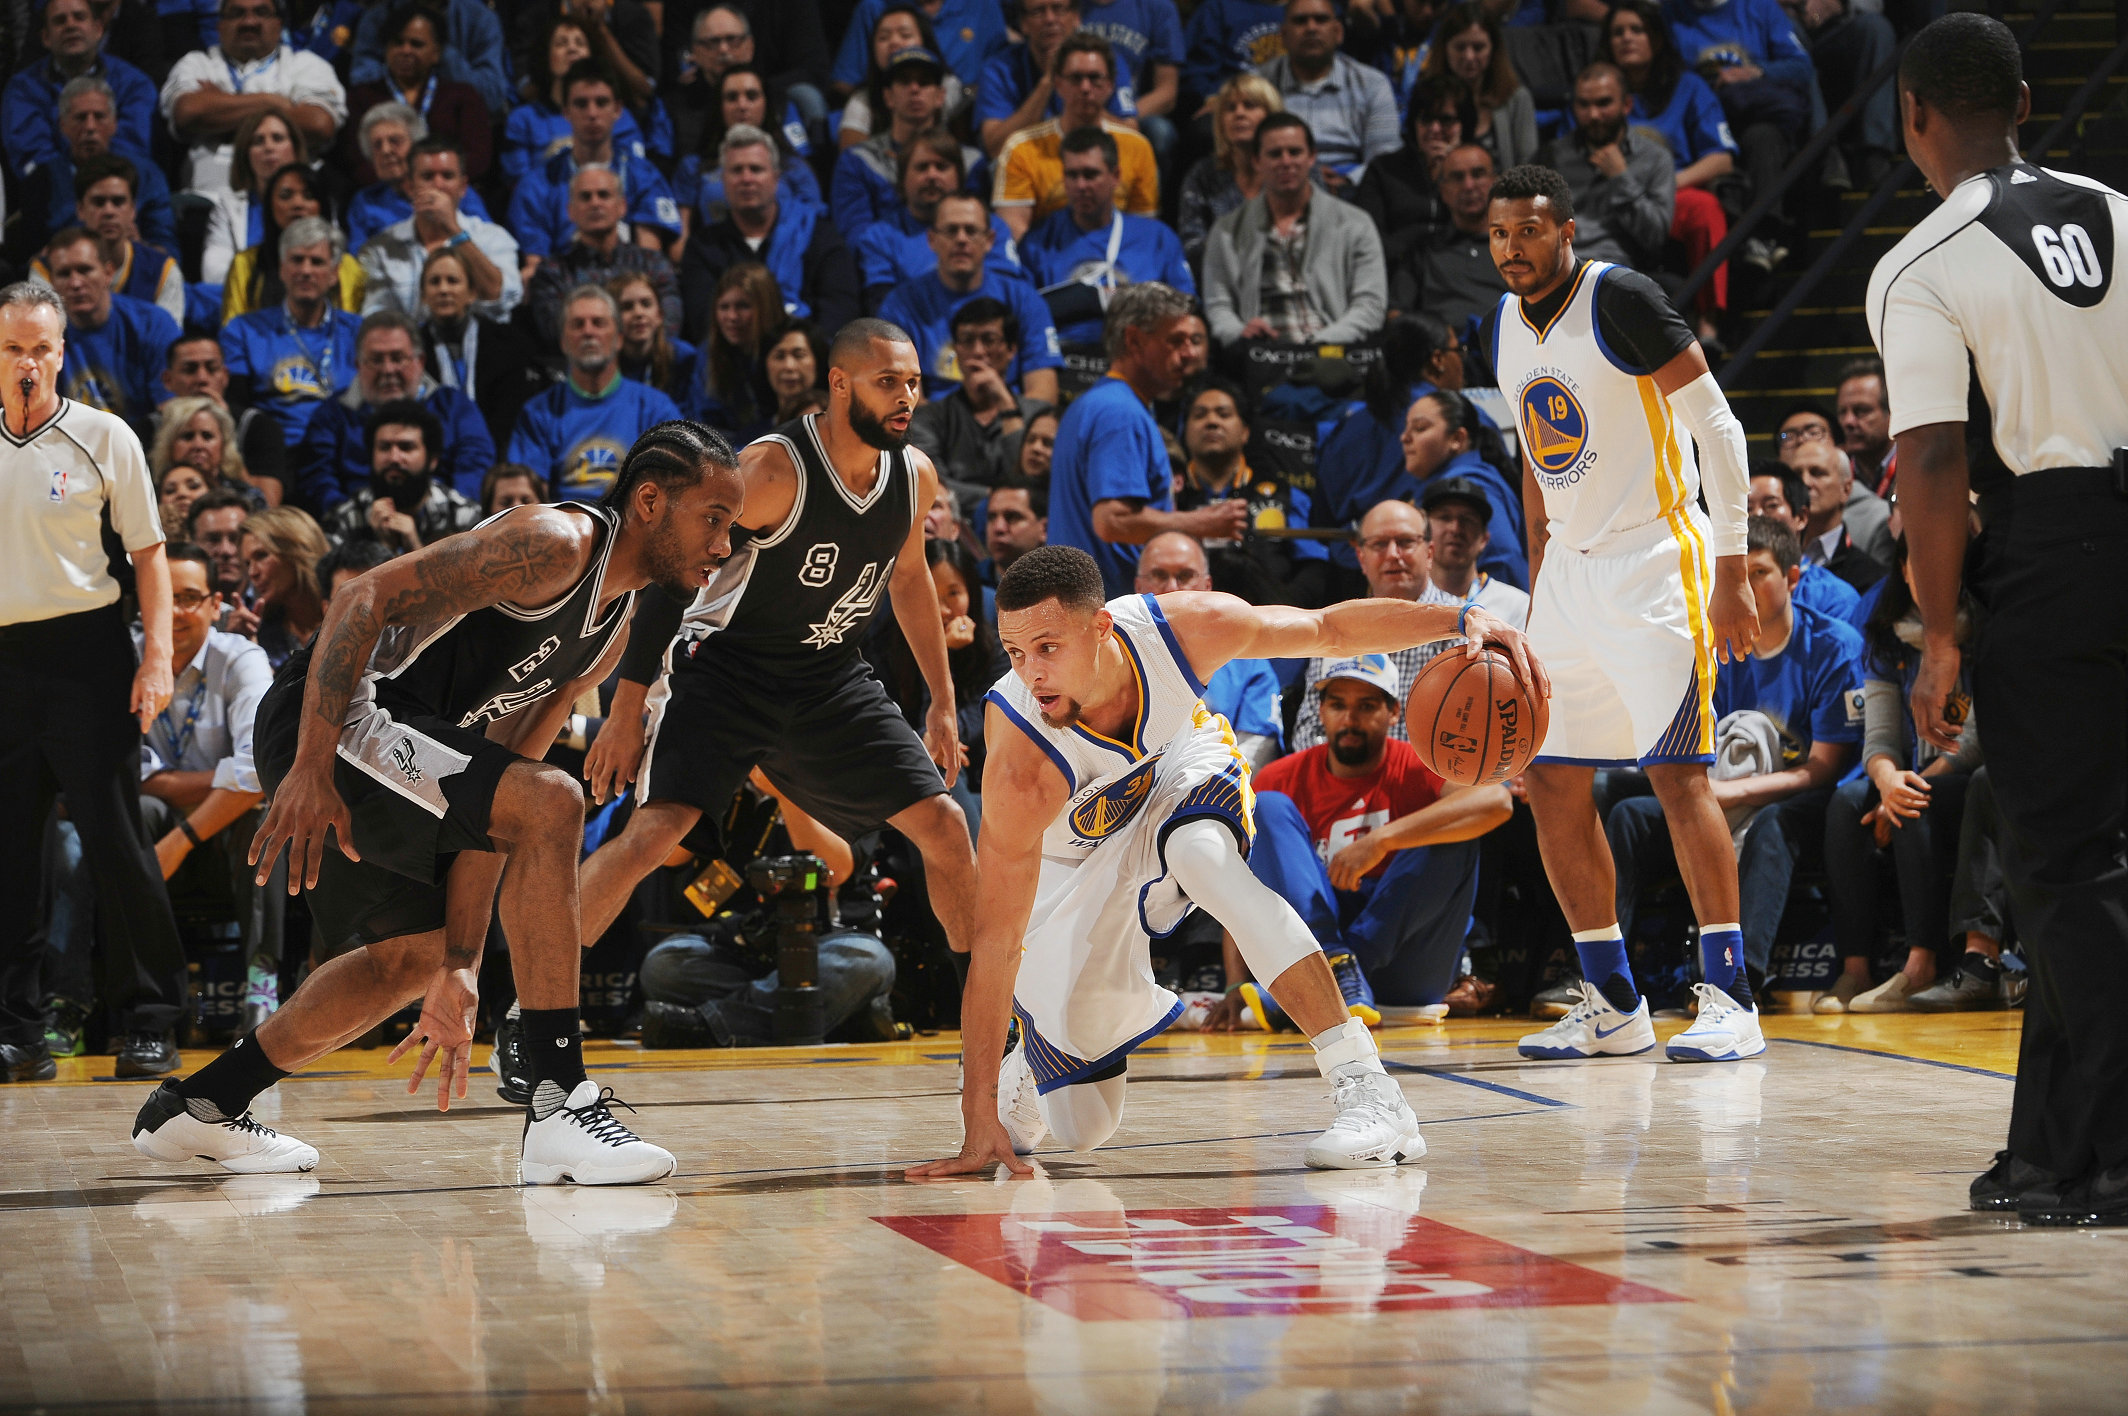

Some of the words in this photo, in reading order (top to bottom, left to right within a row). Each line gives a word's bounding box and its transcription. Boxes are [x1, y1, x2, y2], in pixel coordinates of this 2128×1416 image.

[2031, 223, 2103, 288] 60
[1551, 366, 1580, 394] STATE
[1548, 395, 1568, 421] 19
[798, 543, 840, 587] 8
[508, 635, 561, 683] 2
[1073, 784, 1106, 804] GOL
[1016, 1215, 1496, 1305] ORACLE
